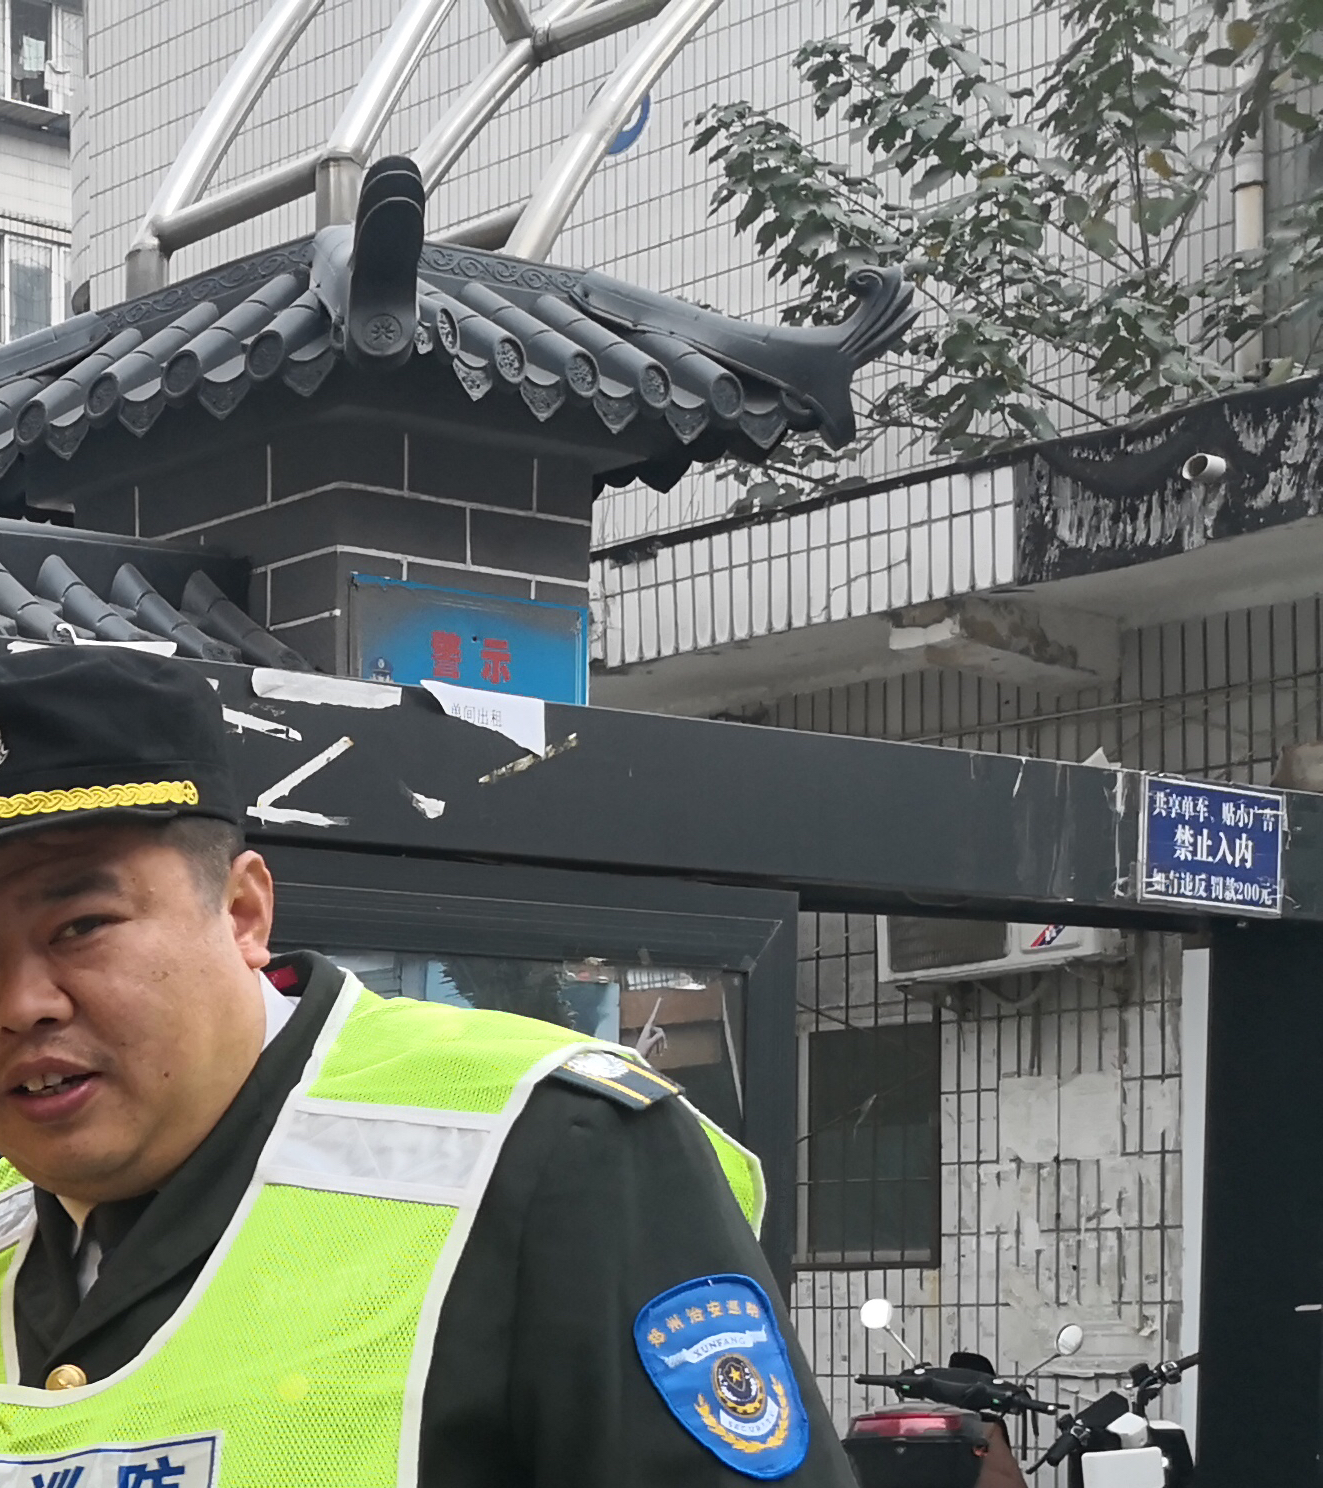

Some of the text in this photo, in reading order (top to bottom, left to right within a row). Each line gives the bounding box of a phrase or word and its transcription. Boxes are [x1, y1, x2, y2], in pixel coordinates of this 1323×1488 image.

[431, 629, 512, 685] 警示
[1172, 824, 1254, 870] 禁止入内
[693, 1336, 747, 1359] XUNFANG
